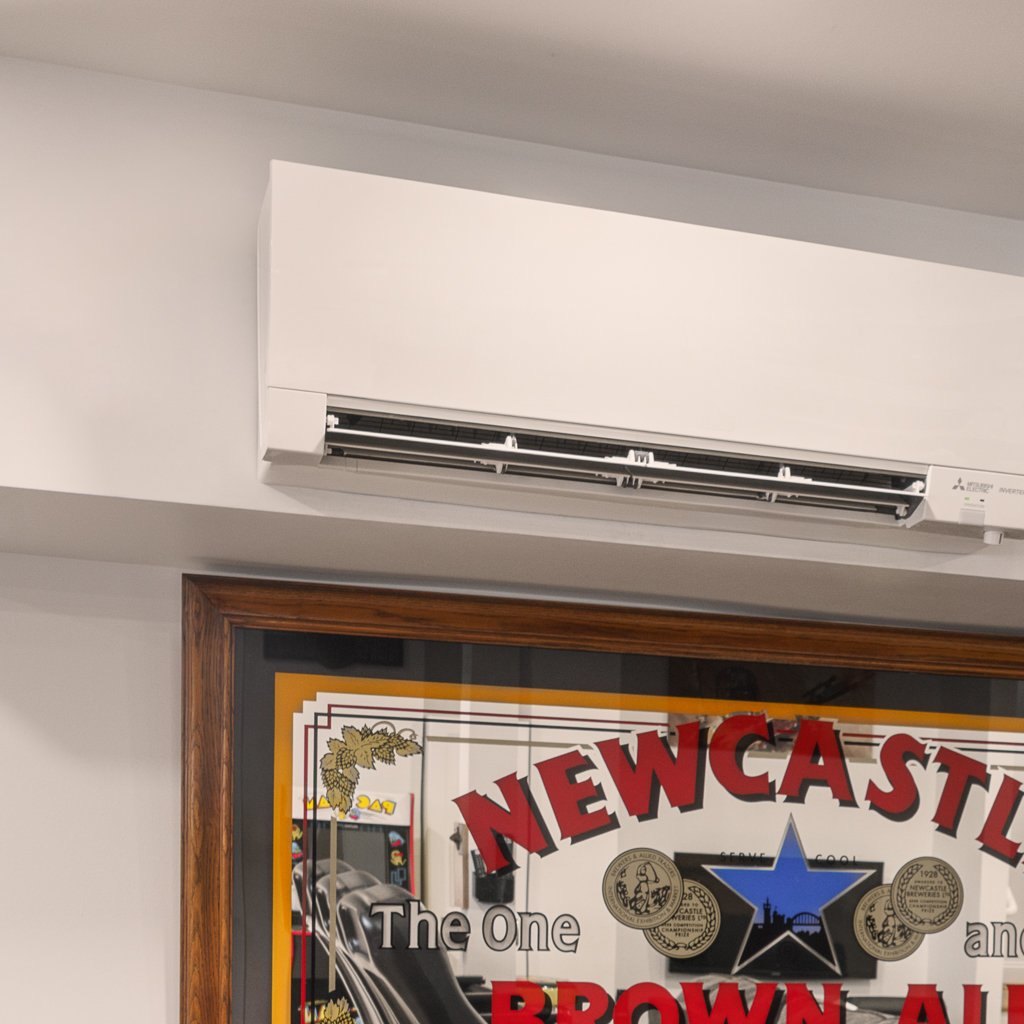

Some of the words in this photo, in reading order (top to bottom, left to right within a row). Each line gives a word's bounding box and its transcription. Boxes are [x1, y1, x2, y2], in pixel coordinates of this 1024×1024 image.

[815, 854, 858, 865] COOL
[920, 870, 938, 878] 1928
[370, 900, 470, 952] The
[482, 902, 581, 953] One
